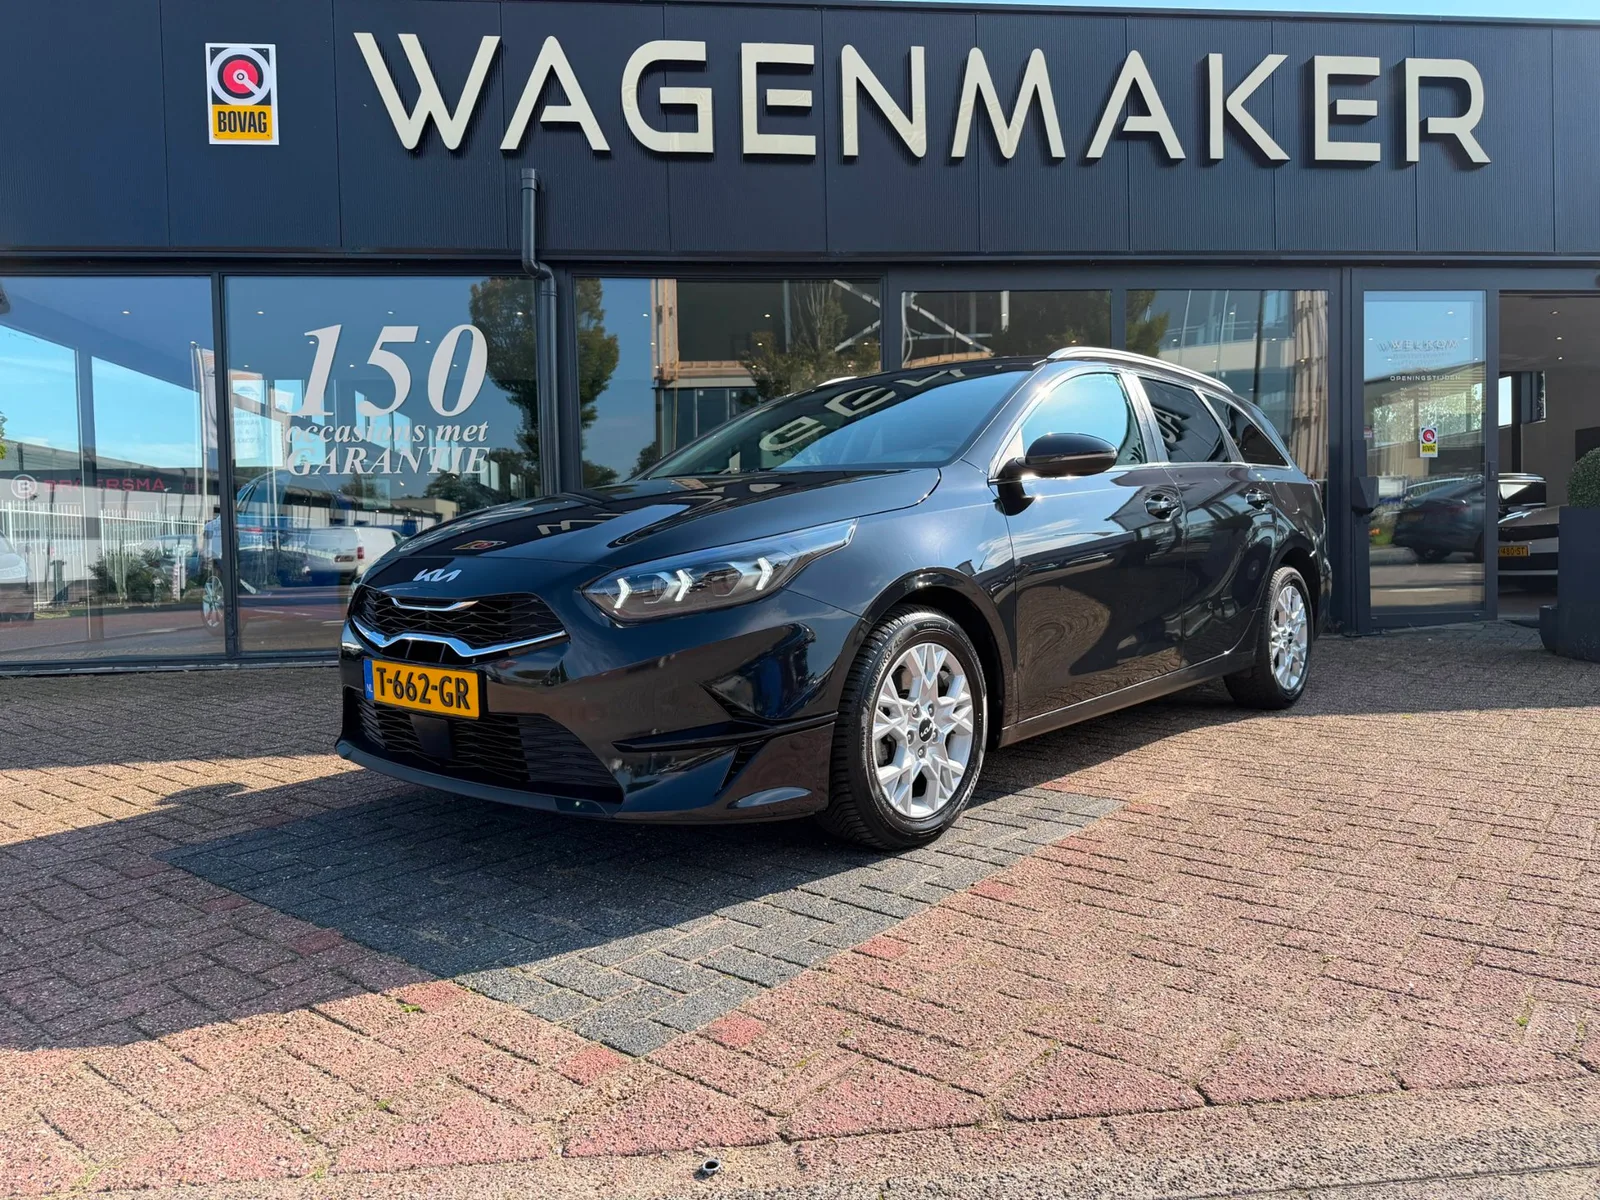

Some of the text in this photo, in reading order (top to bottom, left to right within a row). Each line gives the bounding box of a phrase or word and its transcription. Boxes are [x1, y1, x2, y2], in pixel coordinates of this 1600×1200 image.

[353, 32, 1491, 164] WAGENMAKER
[217, 110, 268, 135] BOVAG
[287, 324, 488, 416] 150
[286, 422, 426, 442] occasions
[435, 420, 489, 442] met
[287, 447, 490, 476] GARANTIE
[376, 667, 470, 709] T-662-GR
